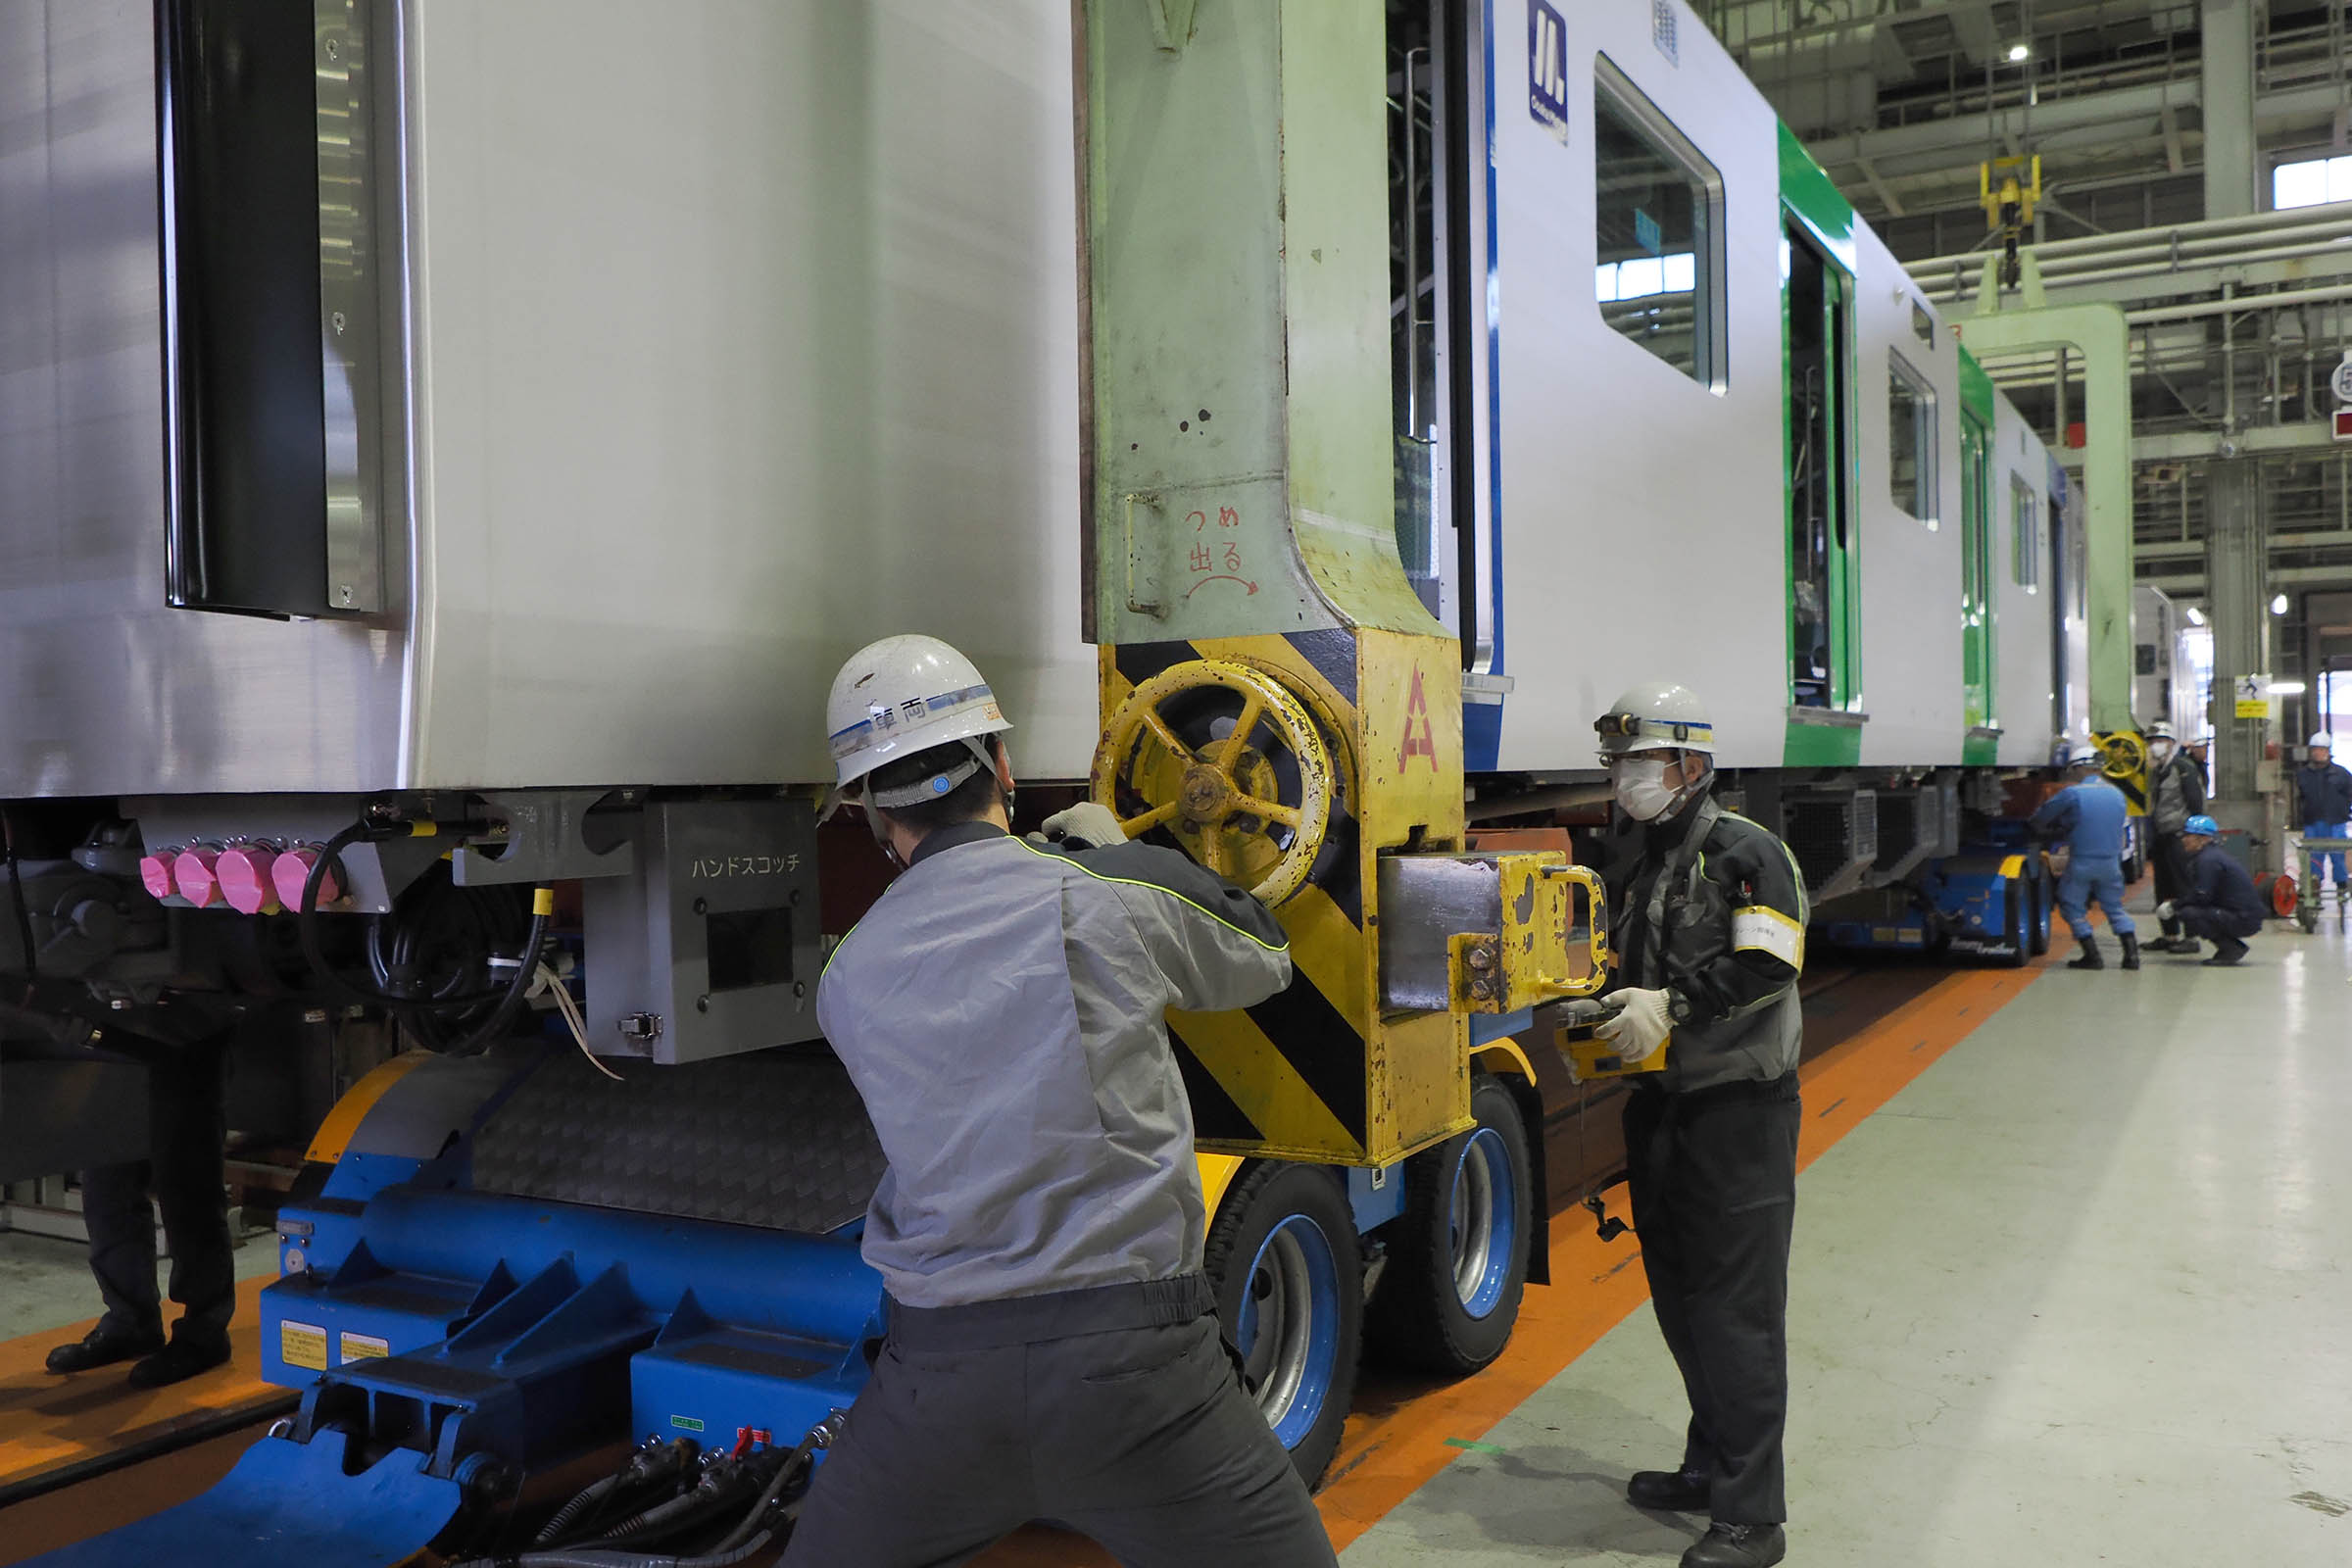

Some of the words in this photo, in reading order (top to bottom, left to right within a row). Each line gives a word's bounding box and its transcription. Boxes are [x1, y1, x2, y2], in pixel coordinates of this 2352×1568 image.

[1185, 506, 1240, 532] つめ
[1190, 541, 1241, 572] 出る
[873, 697, 926, 731] 車両
[1398, 663, 1439, 774] A
[691, 854, 801, 878] ハンドスコッチ
